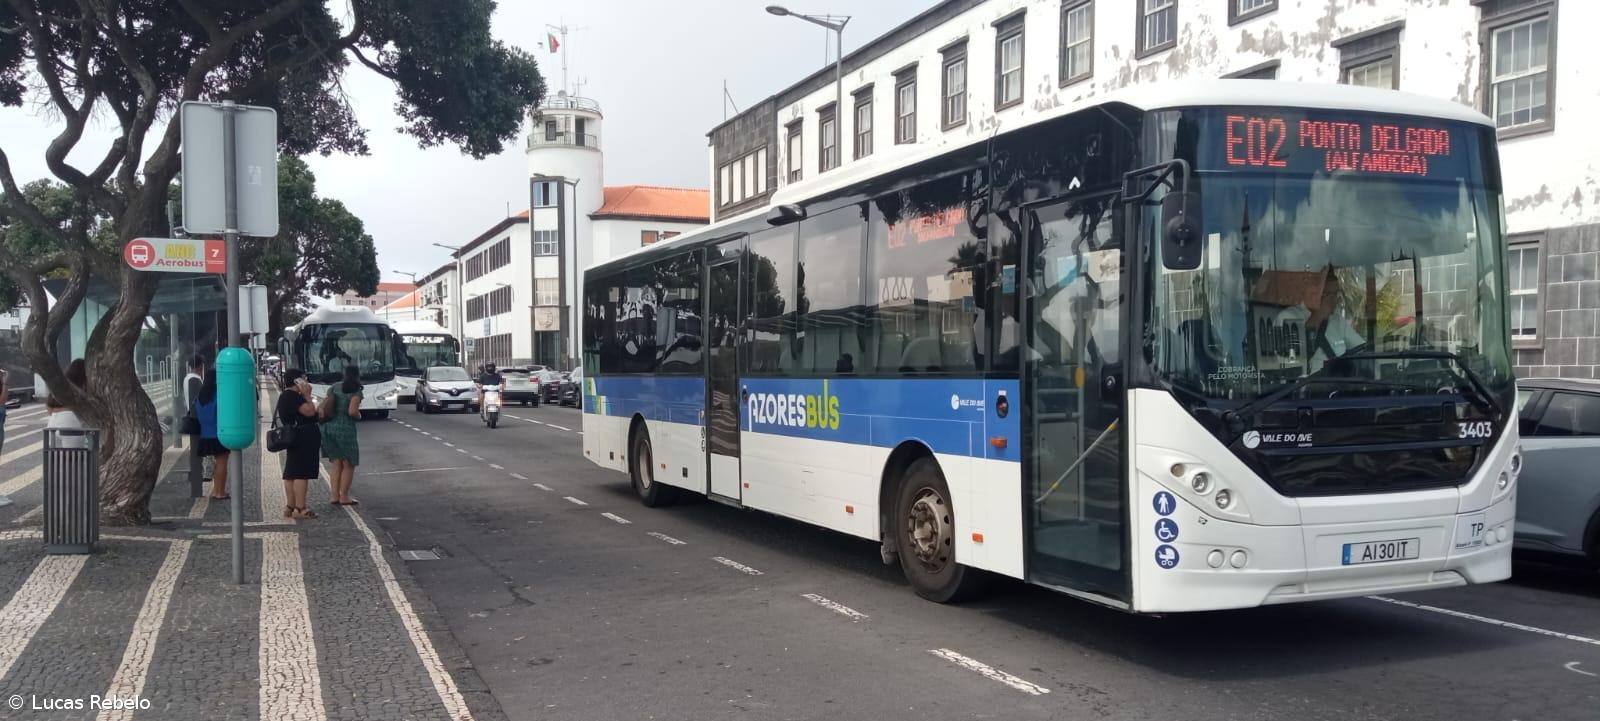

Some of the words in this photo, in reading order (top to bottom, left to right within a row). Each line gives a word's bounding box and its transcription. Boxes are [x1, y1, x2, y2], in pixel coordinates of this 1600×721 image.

[1226, 115, 1287, 168] E02
[1299, 120, 1361, 150] PONTA
[1371, 124, 1450, 156] DELGADA
[1325, 150, 1428, 177] (ALFANDEGA)
[211, 248, 220, 258] 7
[156, 259, 205, 268] Aerobus
[1458, 421, 1492, 439] 3403
[1262, 433, 1283, 443] VALE
[1284, 433, 1297, 442] DO
[1297, 433, 1313, 442] AVE
[1471, 522, 1484, 537] TP
